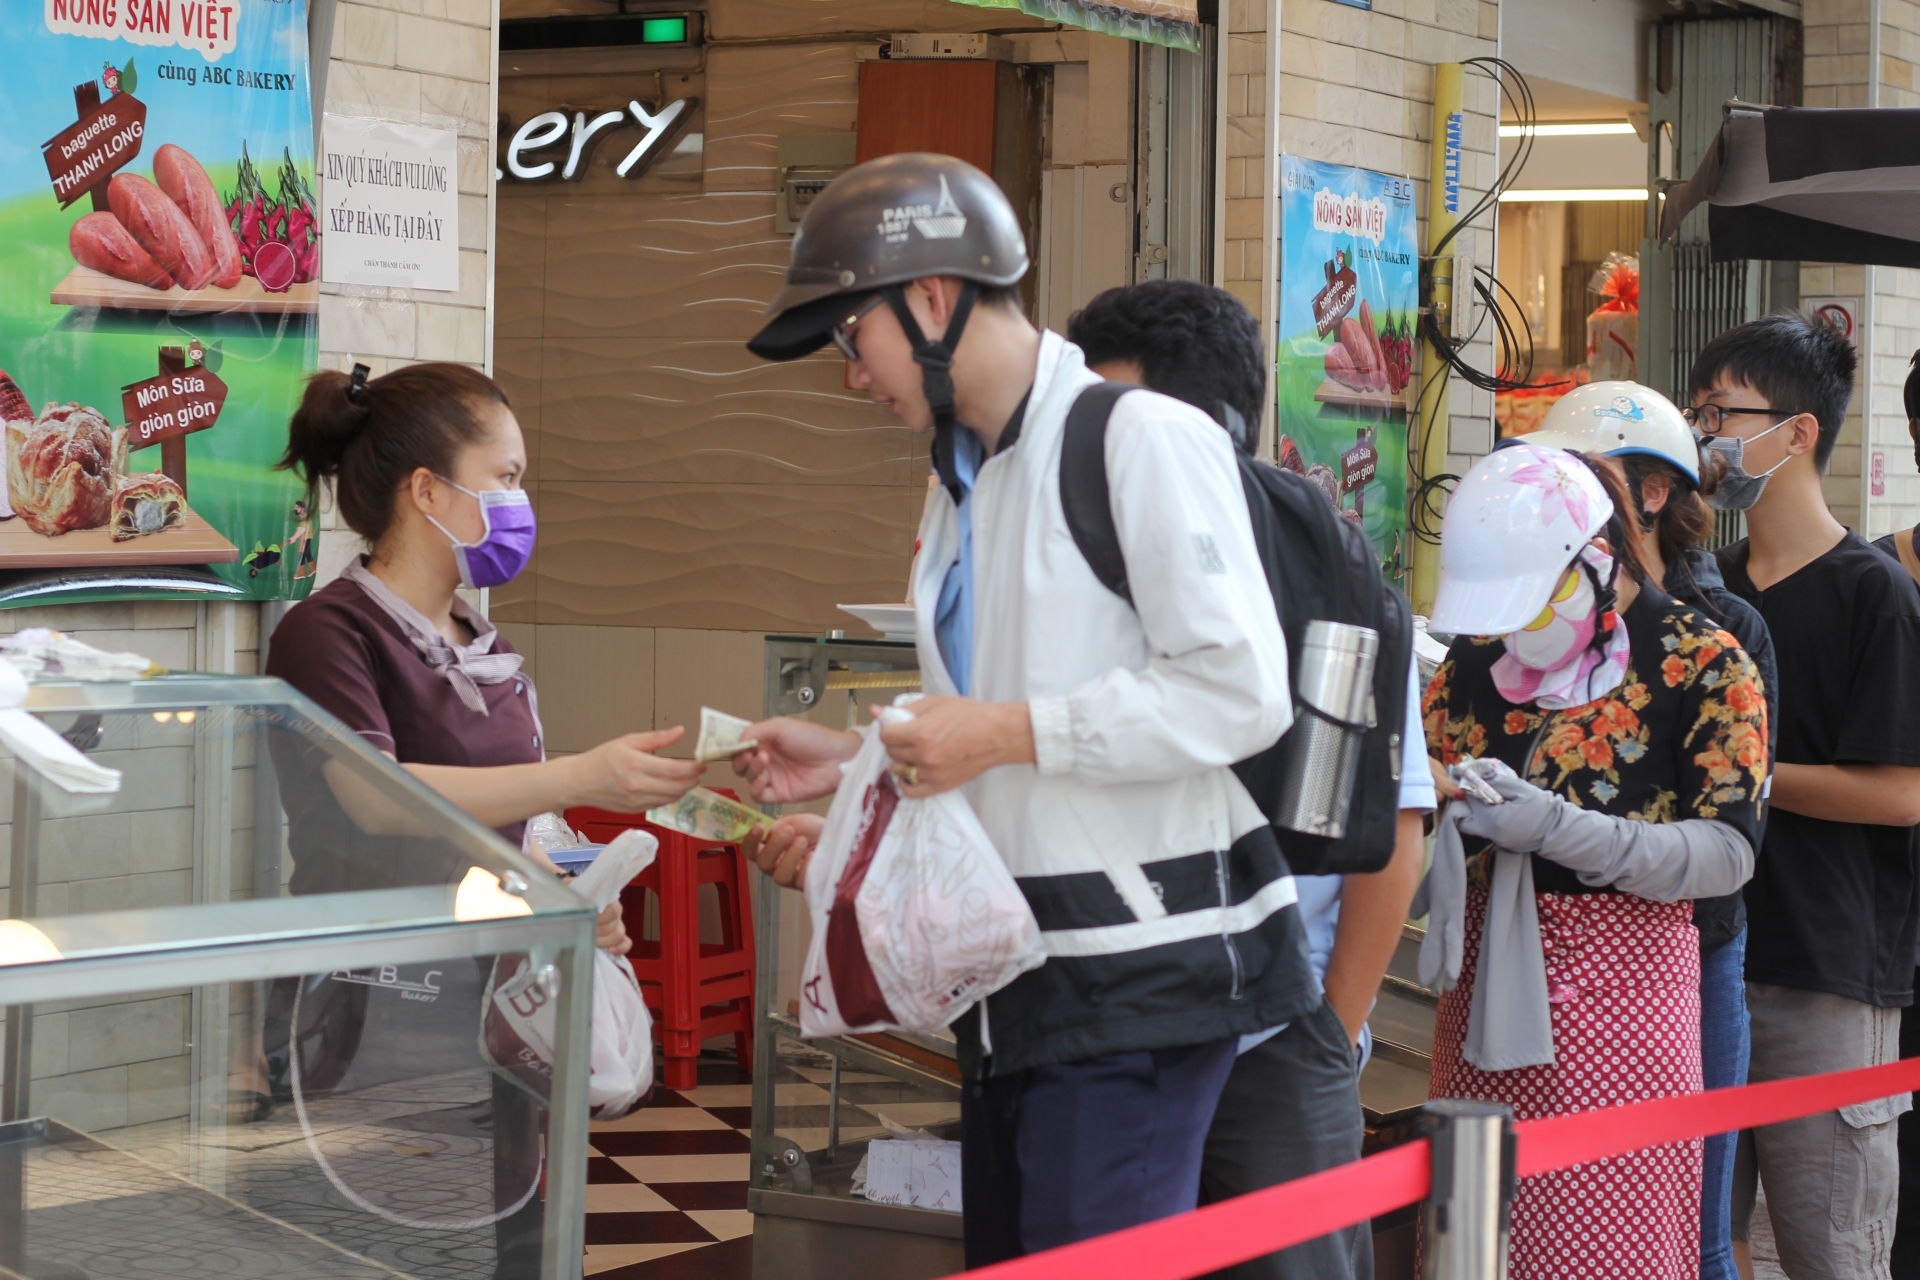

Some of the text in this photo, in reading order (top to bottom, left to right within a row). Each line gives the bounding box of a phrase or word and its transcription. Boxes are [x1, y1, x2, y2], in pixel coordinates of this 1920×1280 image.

[157, 60, 296, 91] cùng ABC BAKERY
[52, 120, 144, 194] THANH LONG
[60, 112, 117, 160] baguette
[496, 99, 686, 180] ery
[327, 149, 447, 192] XIN QUÝ KHÁCH VUI LÒNG
[330, 198, 443, 243] XẾP HÀNG TẠI ĐÂY
[883, 204, 933, 221] PARIS
[1316, 195, 1384, 239] NÔNG SẢN VIỆT
[1384, 251, 1411, 265] BAKERY
[1317, 284, 1356, 332] THANH LONG
[1319, 280, 1344, 309] baguette
[136, 376, 205, 408] Môn Sữa
[139, 400, 216, 439] giòn giòn
